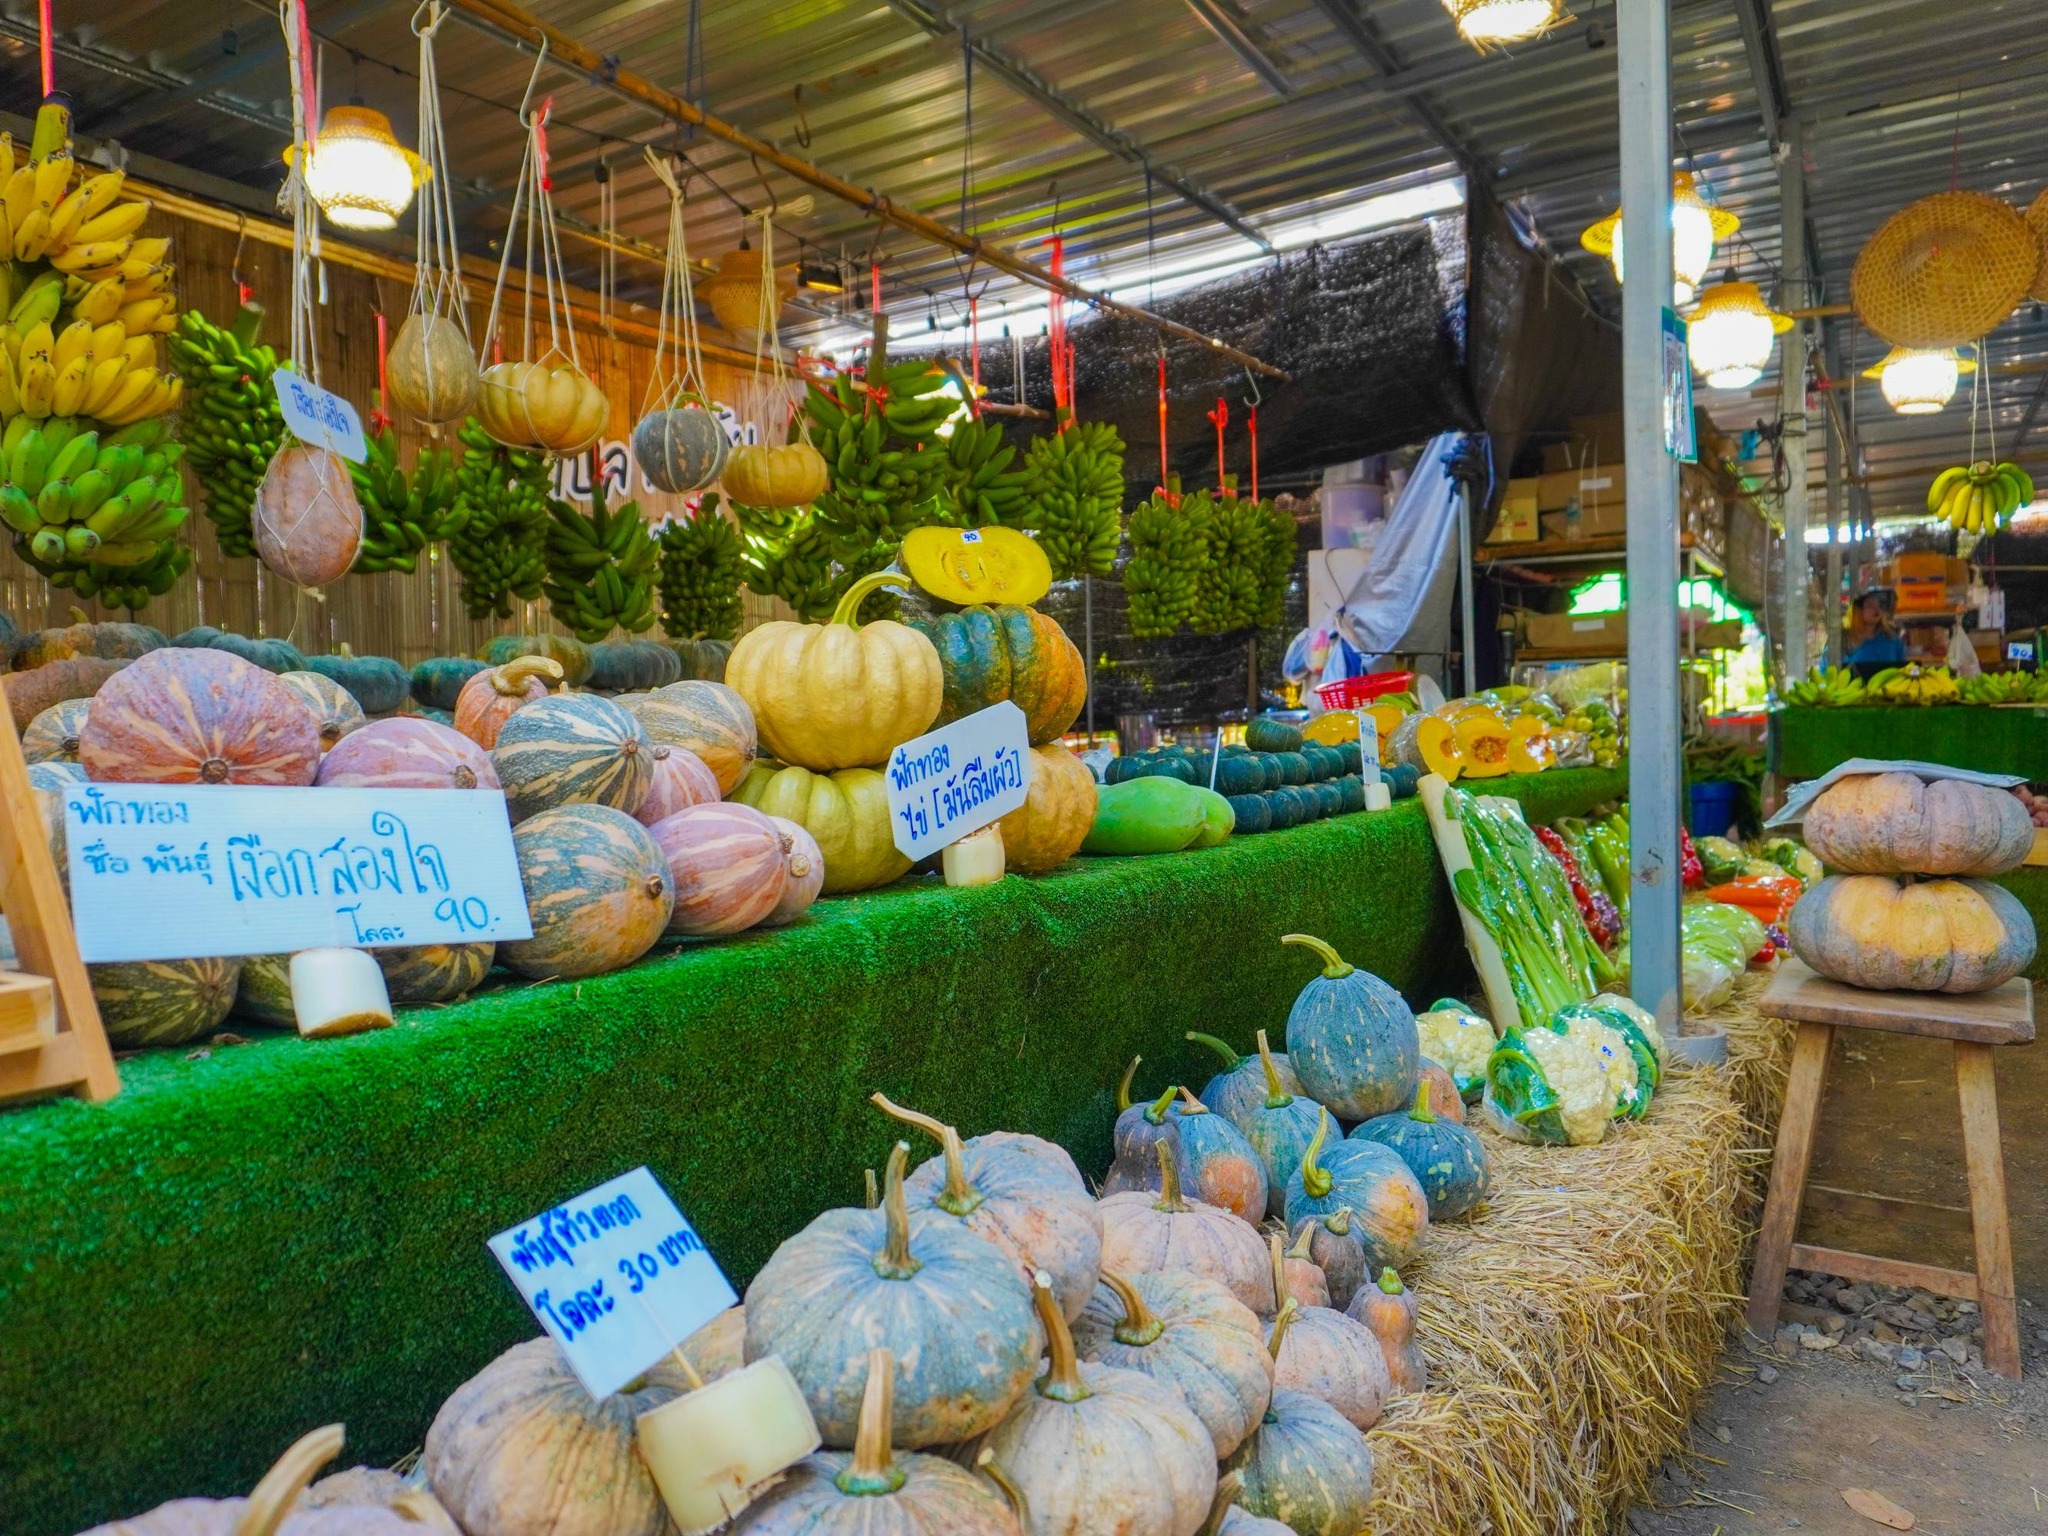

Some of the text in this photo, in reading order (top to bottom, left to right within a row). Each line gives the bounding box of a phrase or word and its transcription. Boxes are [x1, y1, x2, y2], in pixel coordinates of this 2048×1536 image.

[963, 532, 977, 541] 40
[891, 744, 950, 792] ฟักทอง
[69, 787, 189, 824] ฟักทอง
[82, 838, 130, 874] ชื่อ
[142, 841, 213, 885] พันธุ์
[336, 902, 405, 944] โลละ
[617, 1252, 660, 1294] 30
